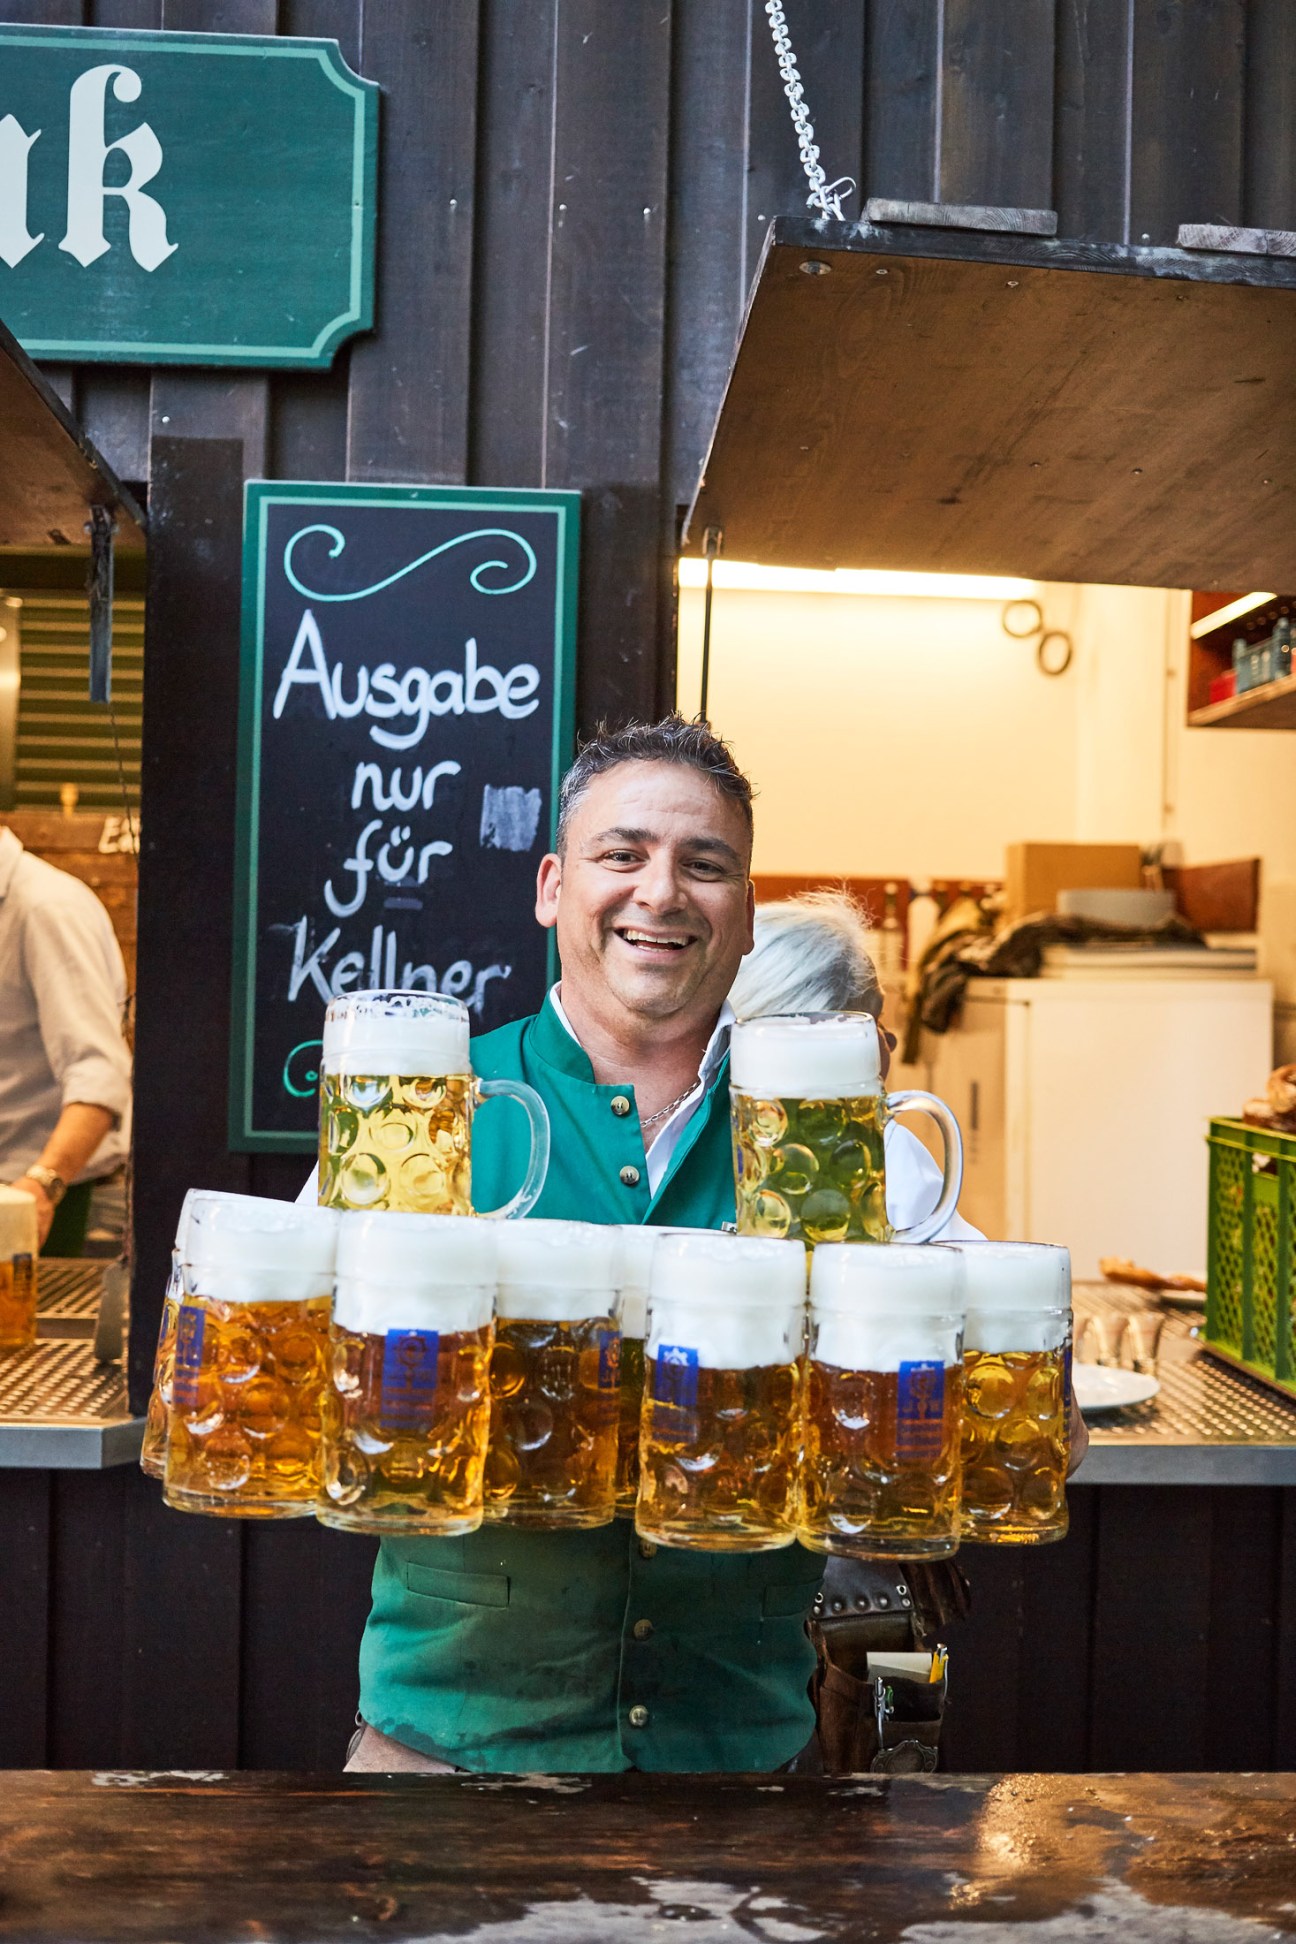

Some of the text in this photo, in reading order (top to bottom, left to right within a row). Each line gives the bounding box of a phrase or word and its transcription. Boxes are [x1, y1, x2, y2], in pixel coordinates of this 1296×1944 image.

[273, 608, 540, 750] Ausgabe
[351, 760, 462, 811] nur
[324, 819, 453, 918] für
[288, 914, 512, 1016] Kellner
